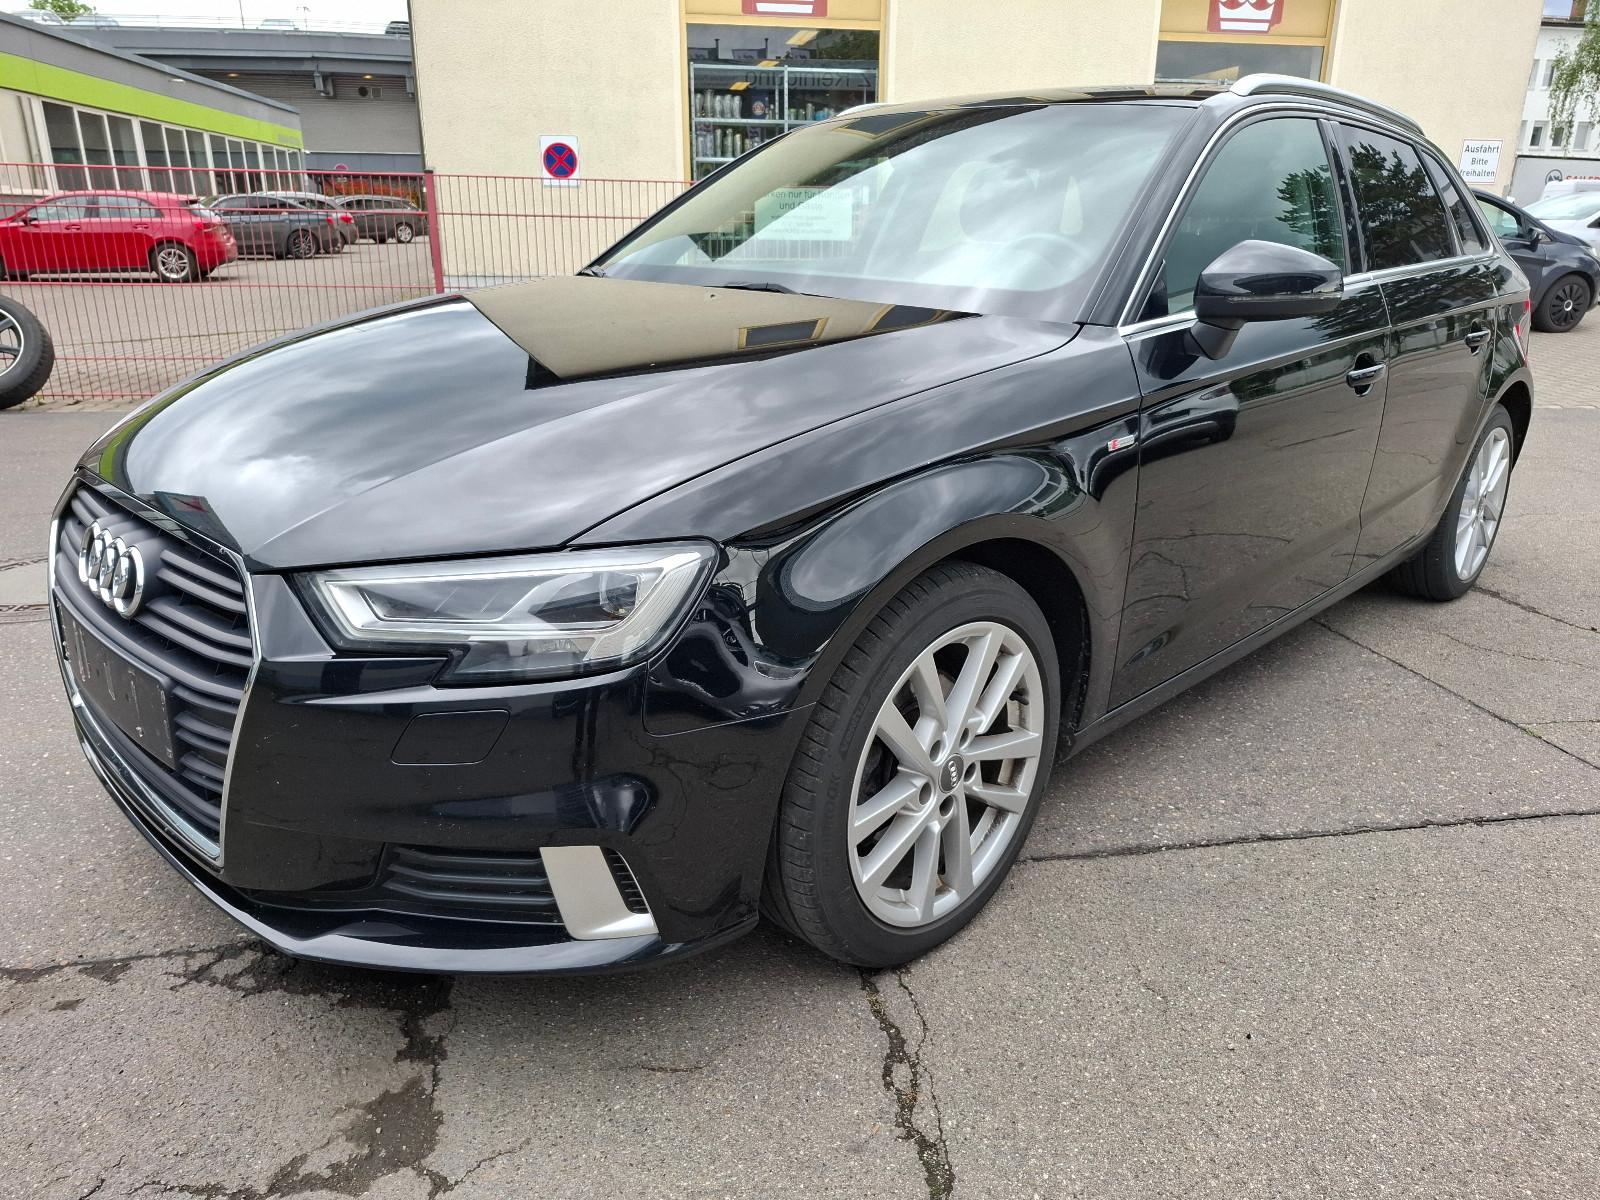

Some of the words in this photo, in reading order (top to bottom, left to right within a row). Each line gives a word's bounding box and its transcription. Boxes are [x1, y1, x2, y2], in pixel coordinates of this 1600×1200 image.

[1464, 144, 1500, 154] Ausfahrt
[1471, 157, 1489, 165] Bitte
[788, 190, 802, 199] nur
[779, 202, 796, 210] und
